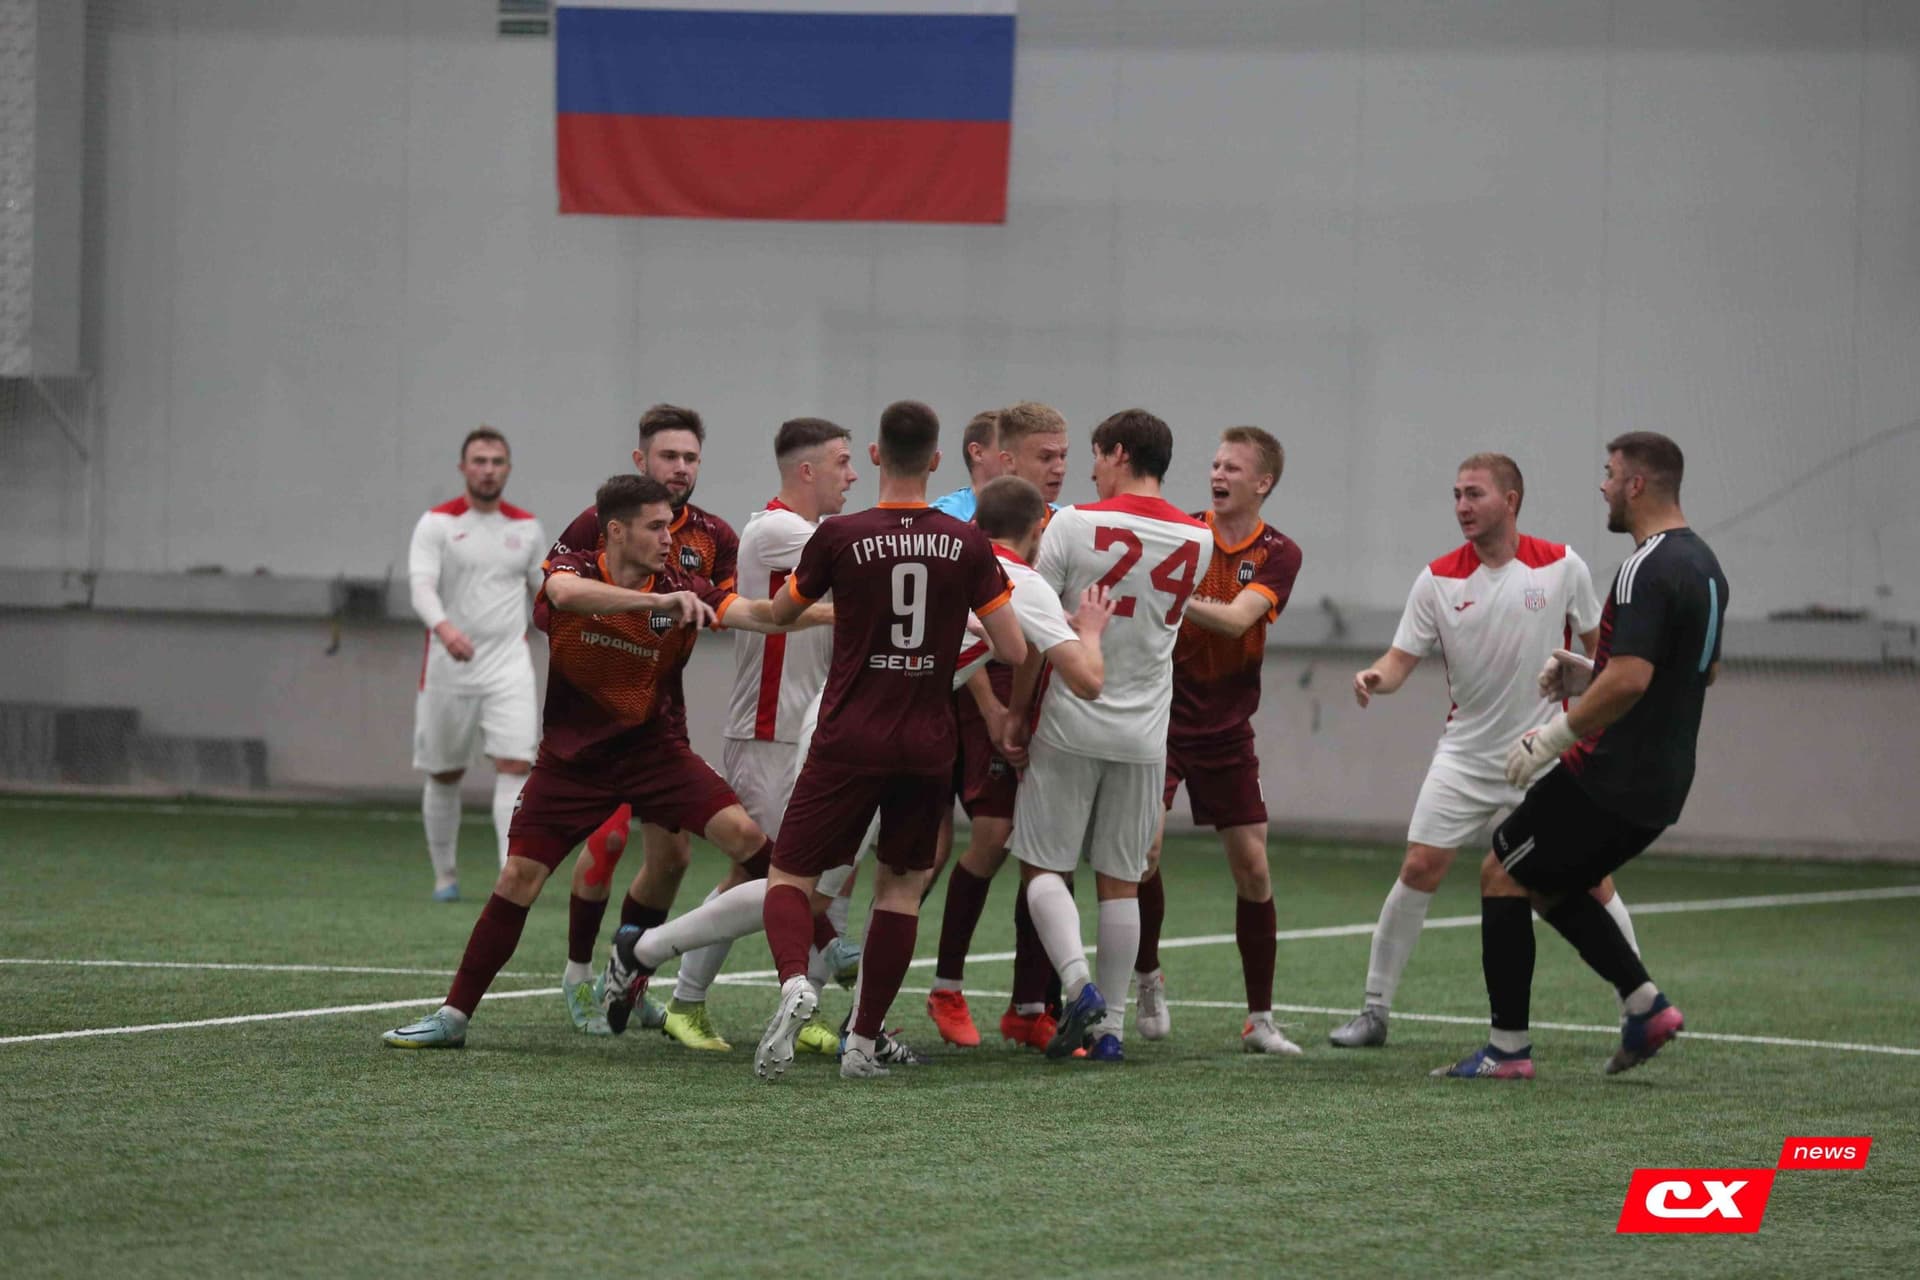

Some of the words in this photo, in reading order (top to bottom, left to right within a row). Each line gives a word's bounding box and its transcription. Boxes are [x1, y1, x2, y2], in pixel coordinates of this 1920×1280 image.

[852, 534, 963, 565] ГРЕЧНИКОВ
[1094, 525, 1200, 625] 24
[891, 562, 928, 649] 9
